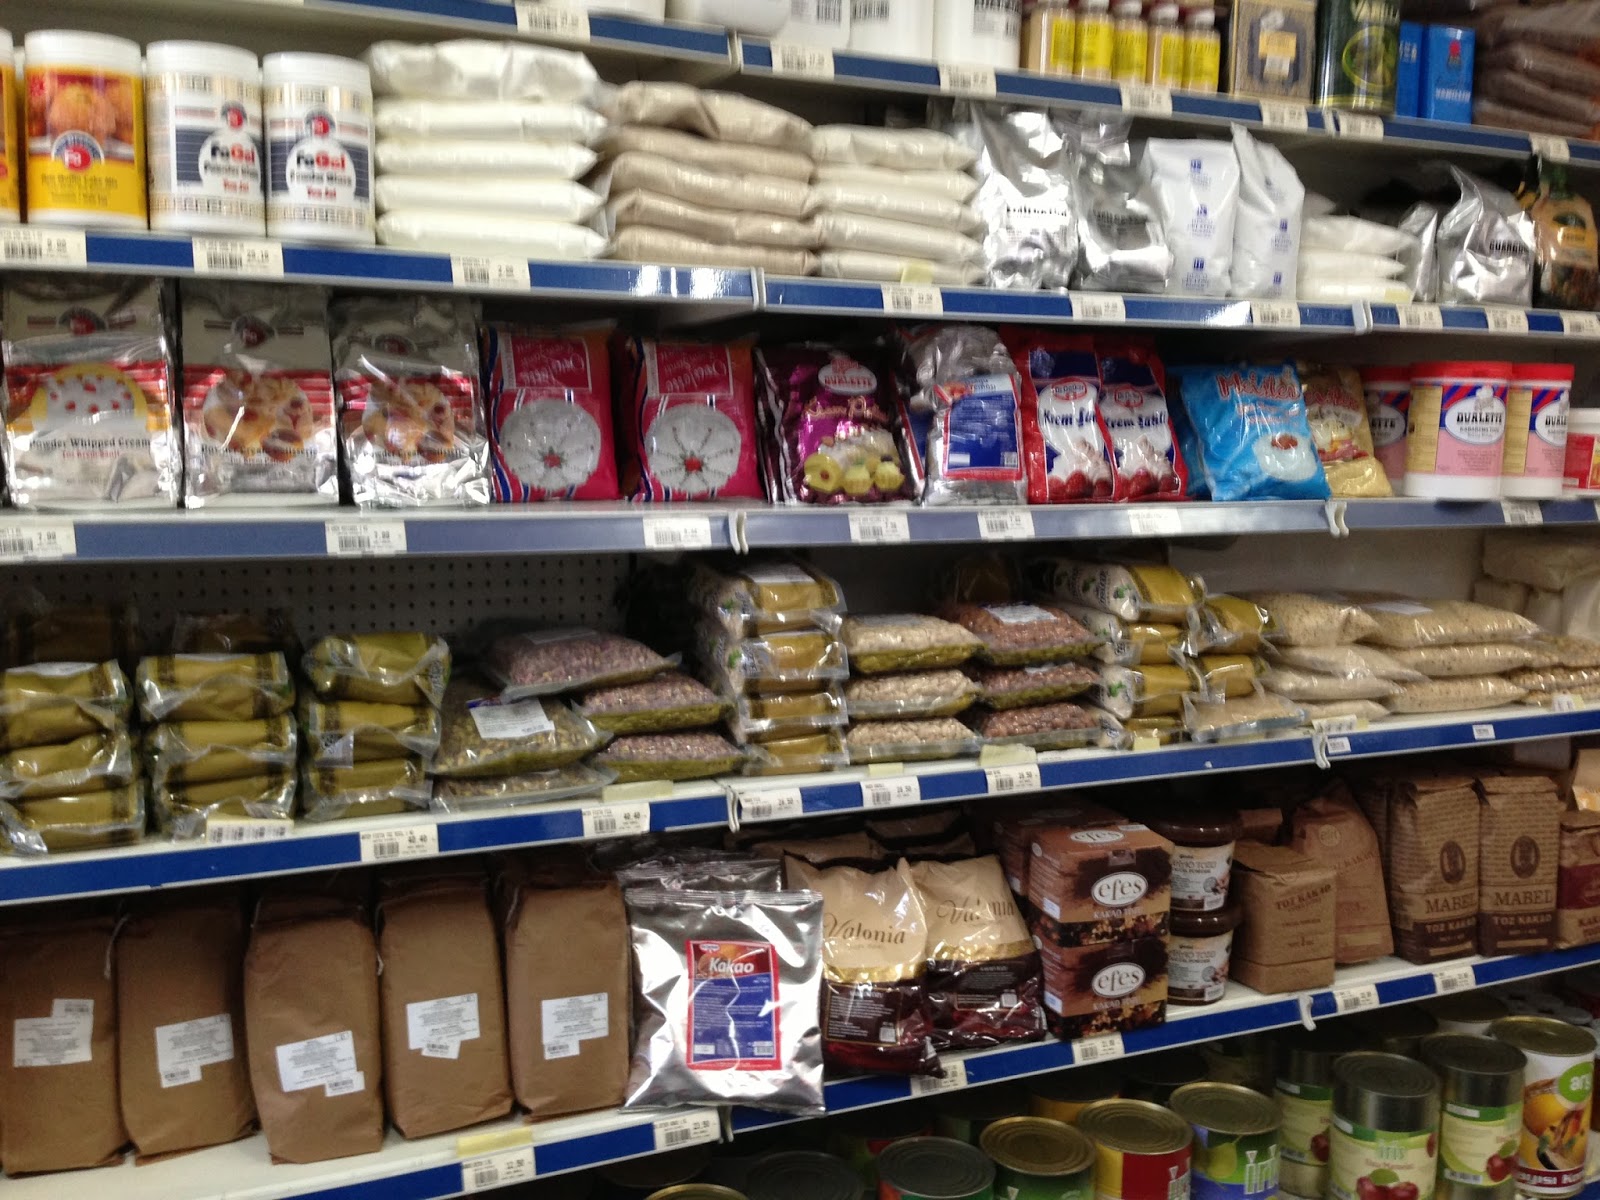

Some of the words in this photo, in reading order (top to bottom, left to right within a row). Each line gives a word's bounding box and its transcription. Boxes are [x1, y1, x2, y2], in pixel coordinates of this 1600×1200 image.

[1098, 878, 1142, 901] efes
[824, 913, 906, 945] Valonia
[709, 958, 754, 974] Kakao
[1098, 970, 1140, 992] efes
